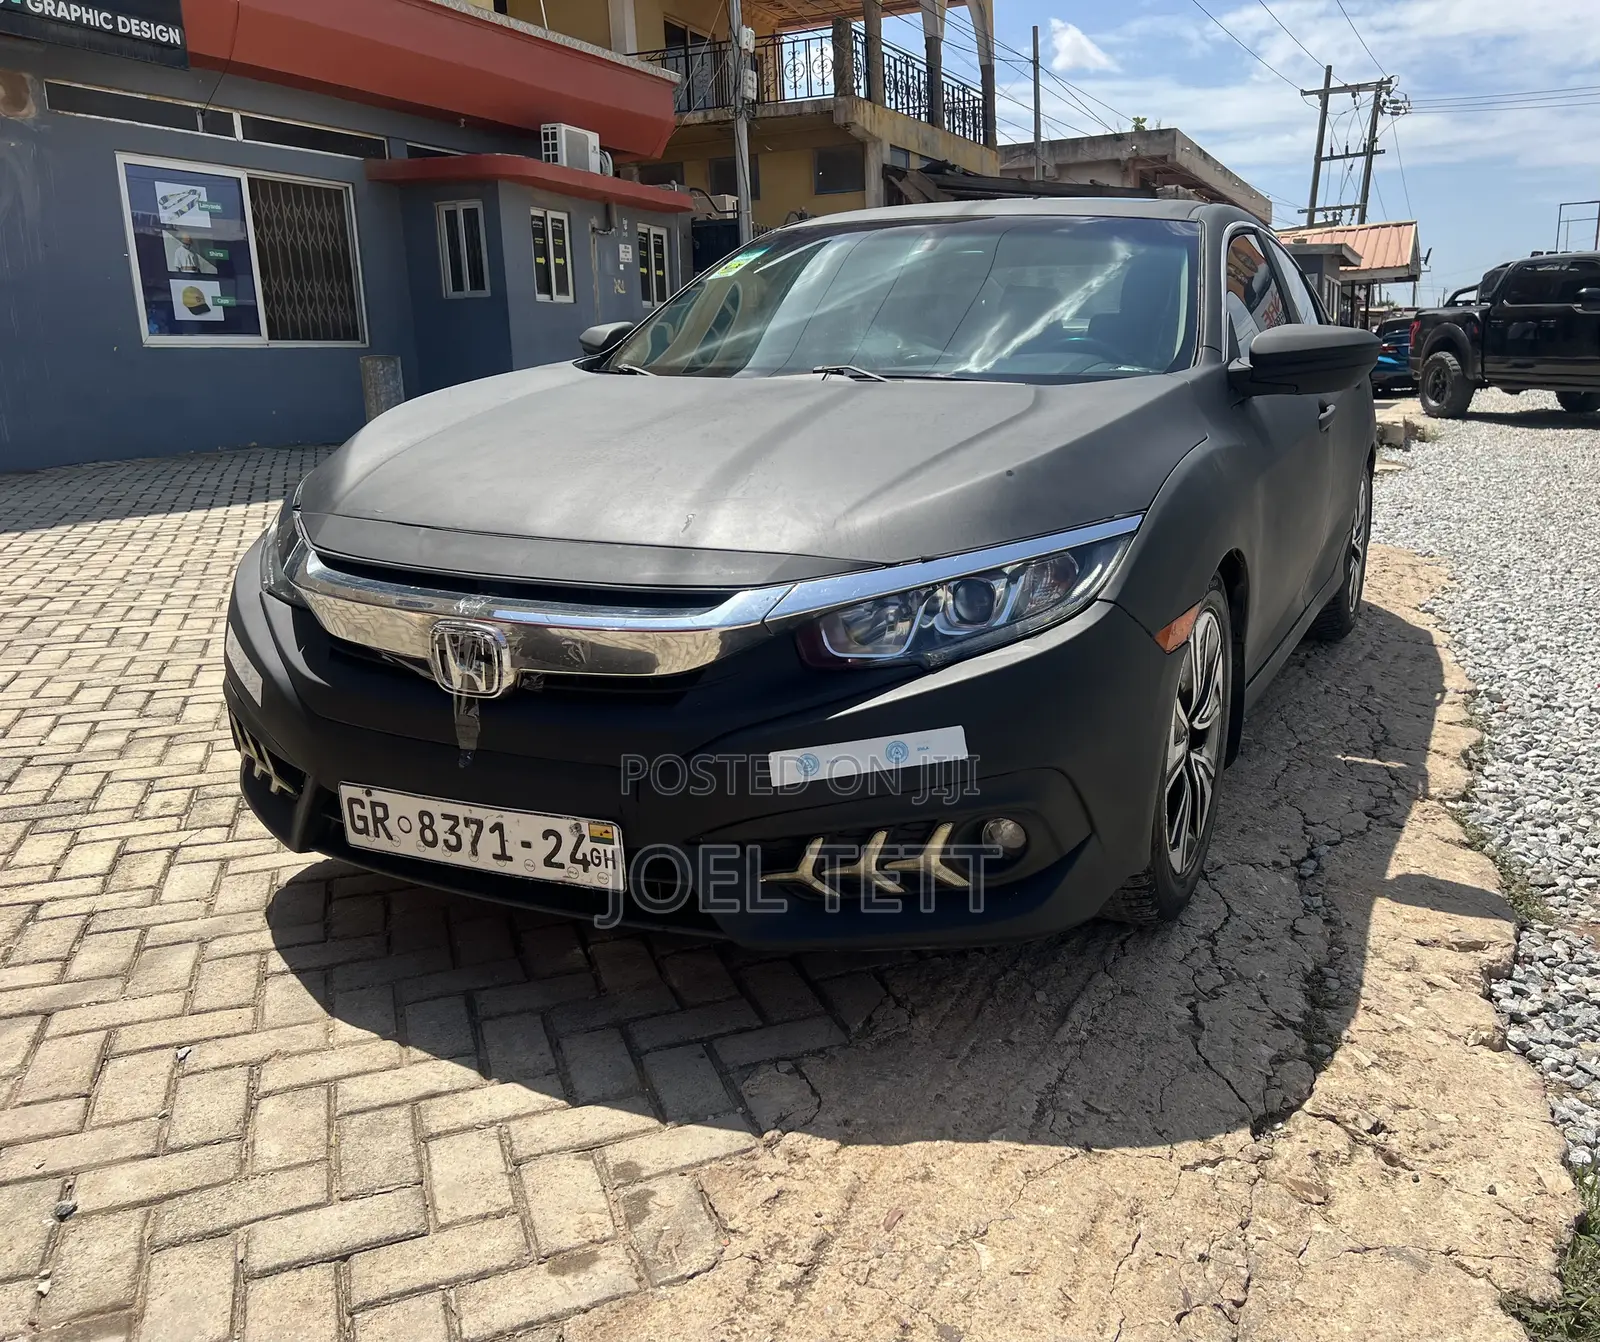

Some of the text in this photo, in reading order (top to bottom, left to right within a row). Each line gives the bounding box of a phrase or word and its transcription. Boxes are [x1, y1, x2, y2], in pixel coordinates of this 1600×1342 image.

[27, 0, 182, 46] GRAPHIC DESIGN
[347, 797, 394, 842] GR
[590, 846, 617, 871] GH
